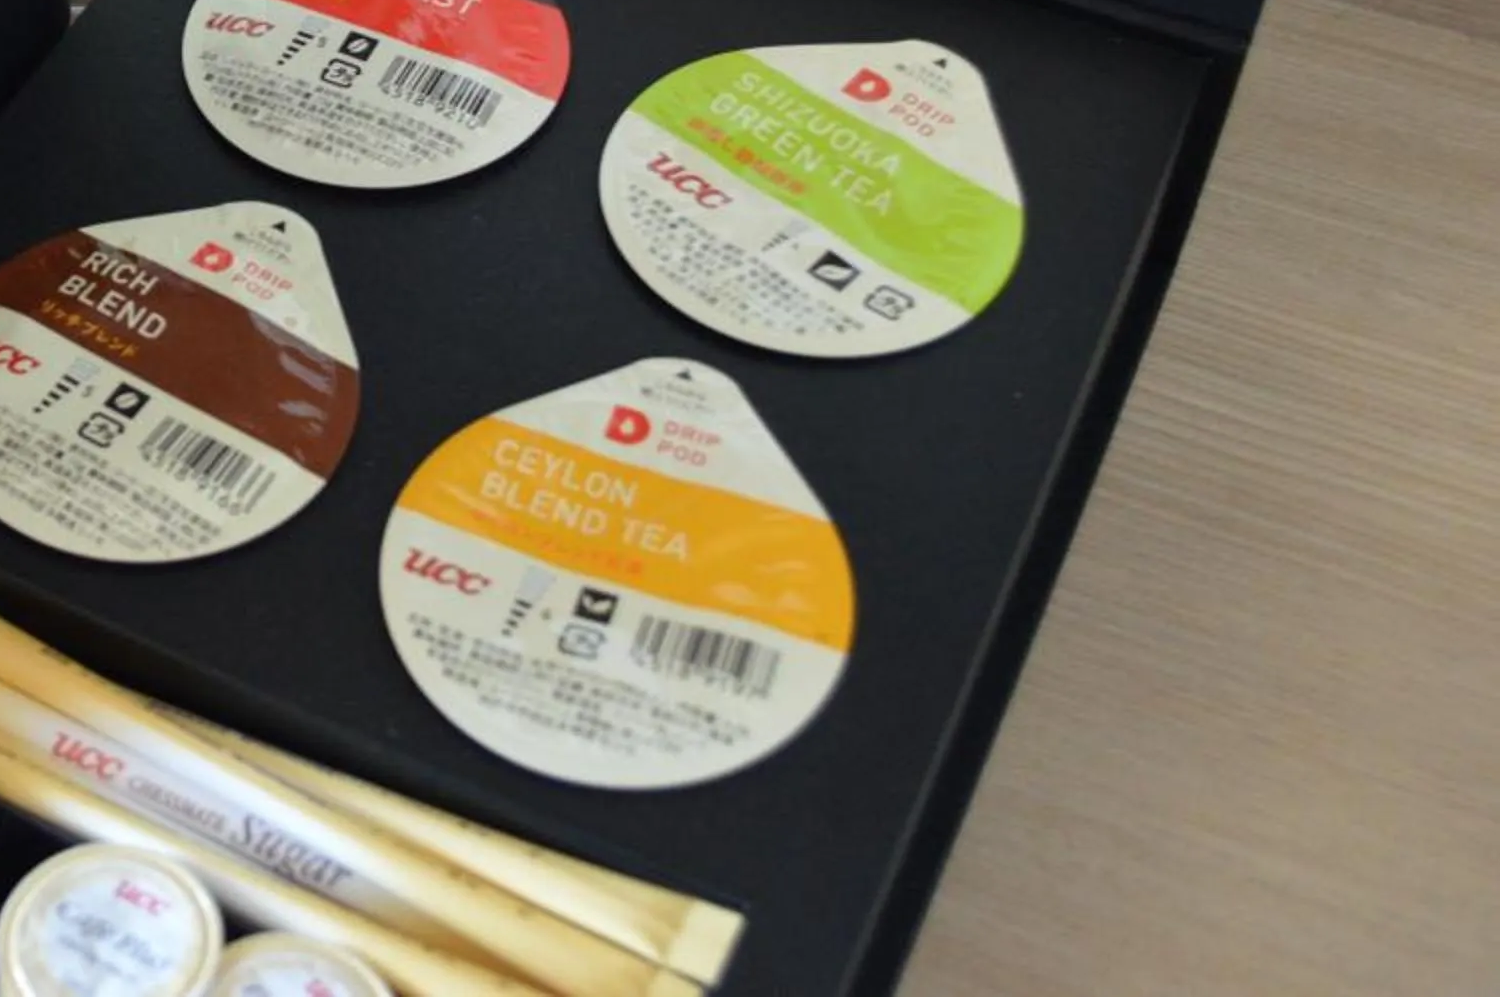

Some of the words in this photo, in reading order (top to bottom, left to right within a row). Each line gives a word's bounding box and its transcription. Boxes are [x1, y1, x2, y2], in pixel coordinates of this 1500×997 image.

[736, 71, 901, 176] SHIZUOKA
[888, 104, 936, 137] POD
[902, 92, 955, 124] DRIP
[709, 92, 824, 173] GREEN
[829, 163, 893, 217] TEA
[80, 250, 160, 296] RICH
[231, 272, 273, 300] POD
[245, 261, 293, 290] DRIP
[41, 299, 139, 357] リッチブレンド
[58, 274, 168, 339] BLEND
[656, 439, 708, 467] POD
[664, 419, 722, 446] DRIP
[494, 439, 639, 508] CEYLON
[480, 470, 610, 537] BLEND
[623, 518, 689, 563] TEA
[229, 811, 353, 888] Sugar
